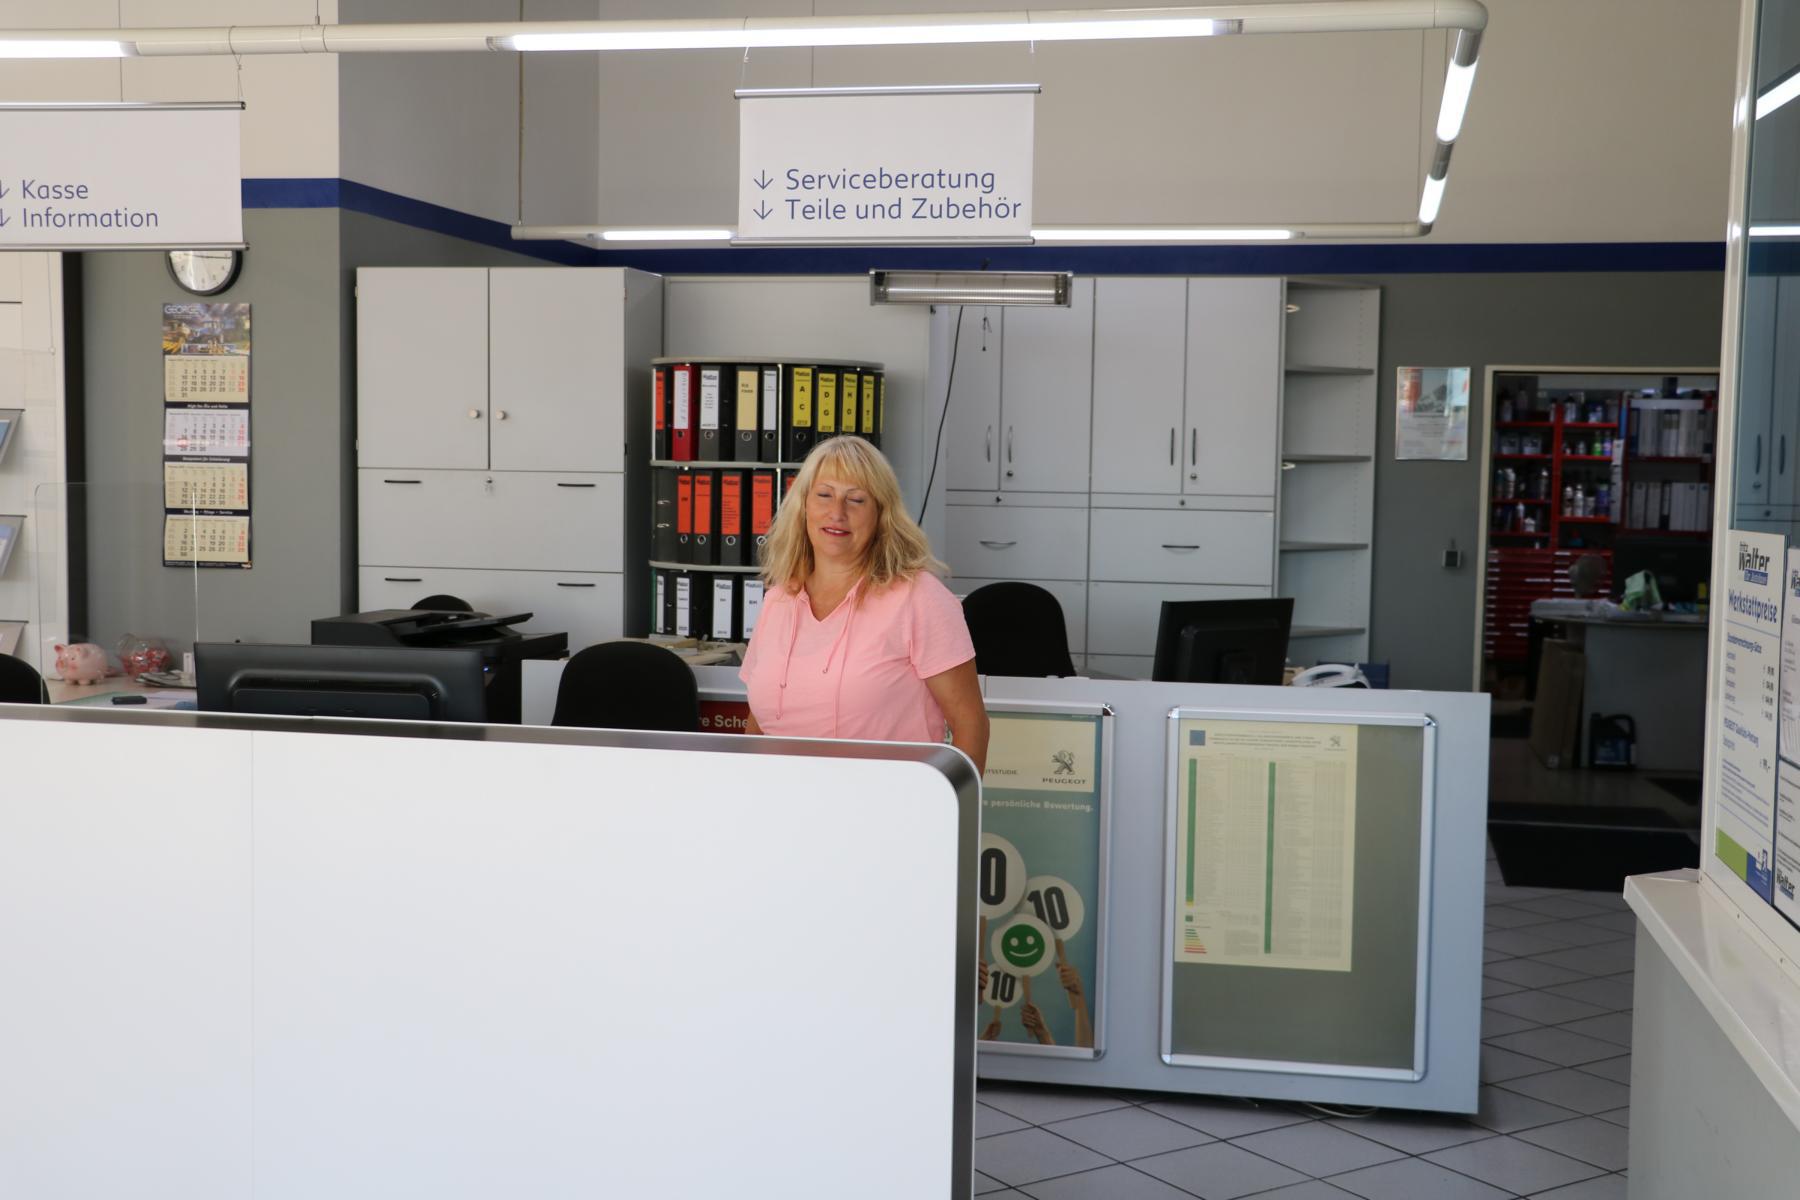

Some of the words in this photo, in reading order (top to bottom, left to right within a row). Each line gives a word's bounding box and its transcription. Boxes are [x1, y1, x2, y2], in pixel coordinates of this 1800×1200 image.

[22, 180, 89, 199] Kasse
[786, 167, 995, 194] Serviceberatung
[23, 207, 158, 228] Information
[785, 198, 846, 220] Teile
[856, 197, 902, 220] und
[912, 197, 1022, 220] Zubehör
[1728, 589, 1778, 624] Werkstattpreise
[714, 714, 748, 728] Sche
[1042, 777, 1086, 785] PEUGEOT
[991, 799, 1040, 809] persönliche
[980, 848, 1007, 906] 0
[1027, 886, 1070, 930] 10
[990, 970, 1016, 1002] 10
